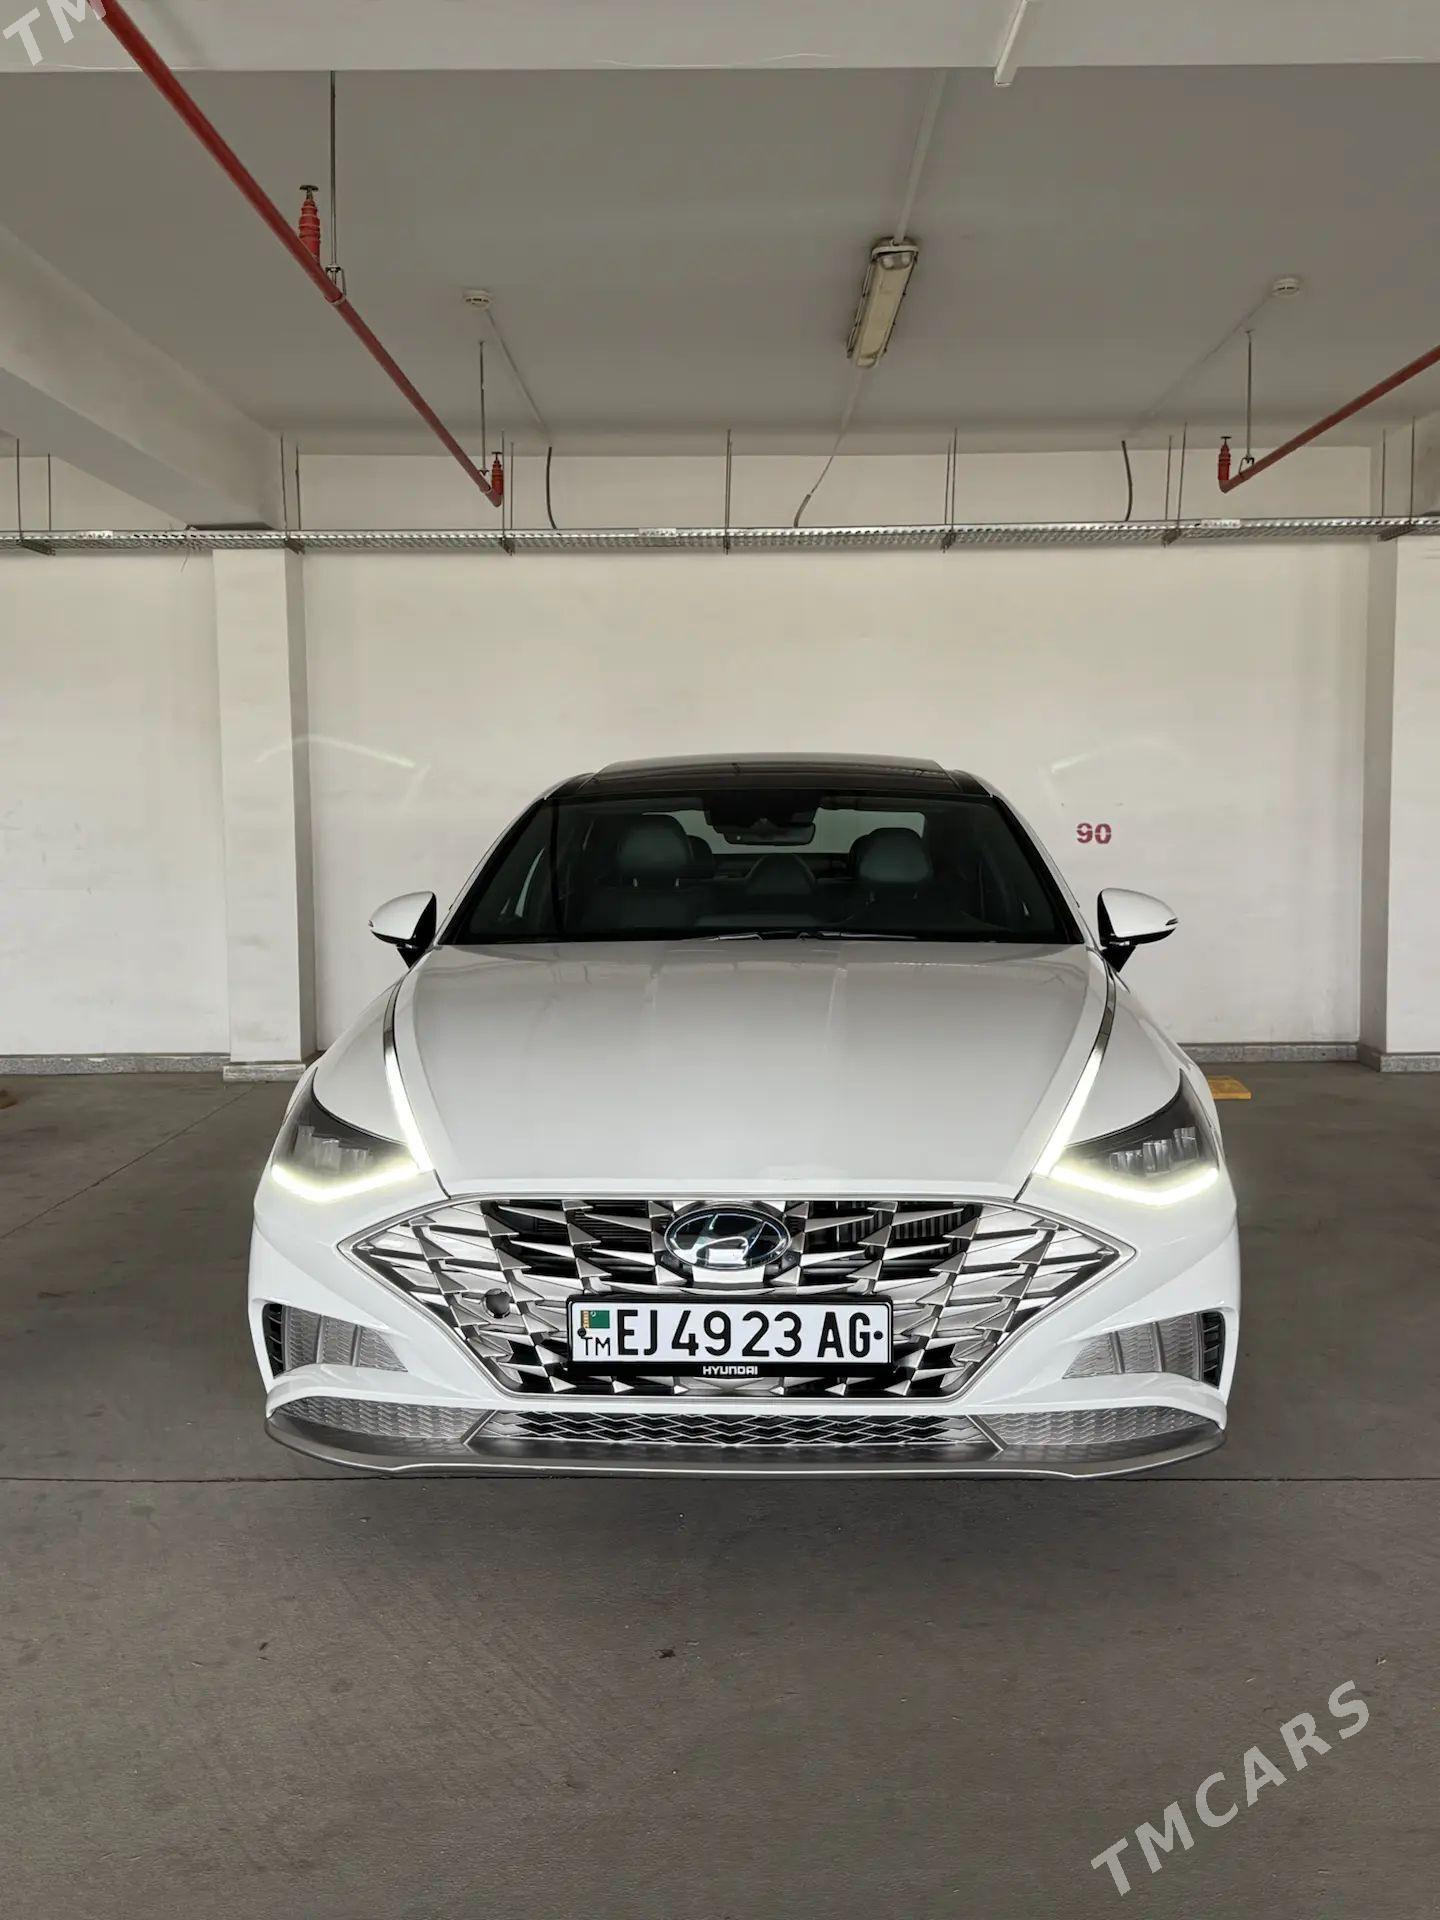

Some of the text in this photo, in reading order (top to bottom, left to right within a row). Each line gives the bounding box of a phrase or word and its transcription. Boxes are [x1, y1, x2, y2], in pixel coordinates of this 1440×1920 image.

[1076, 822, 1112, 845] 90
[617, 1309, 871, 1358] EJ 4923 AG
[583, 1336, 611, 1357] TM
[702, 1365, 759, 1376] HYUNDAI
